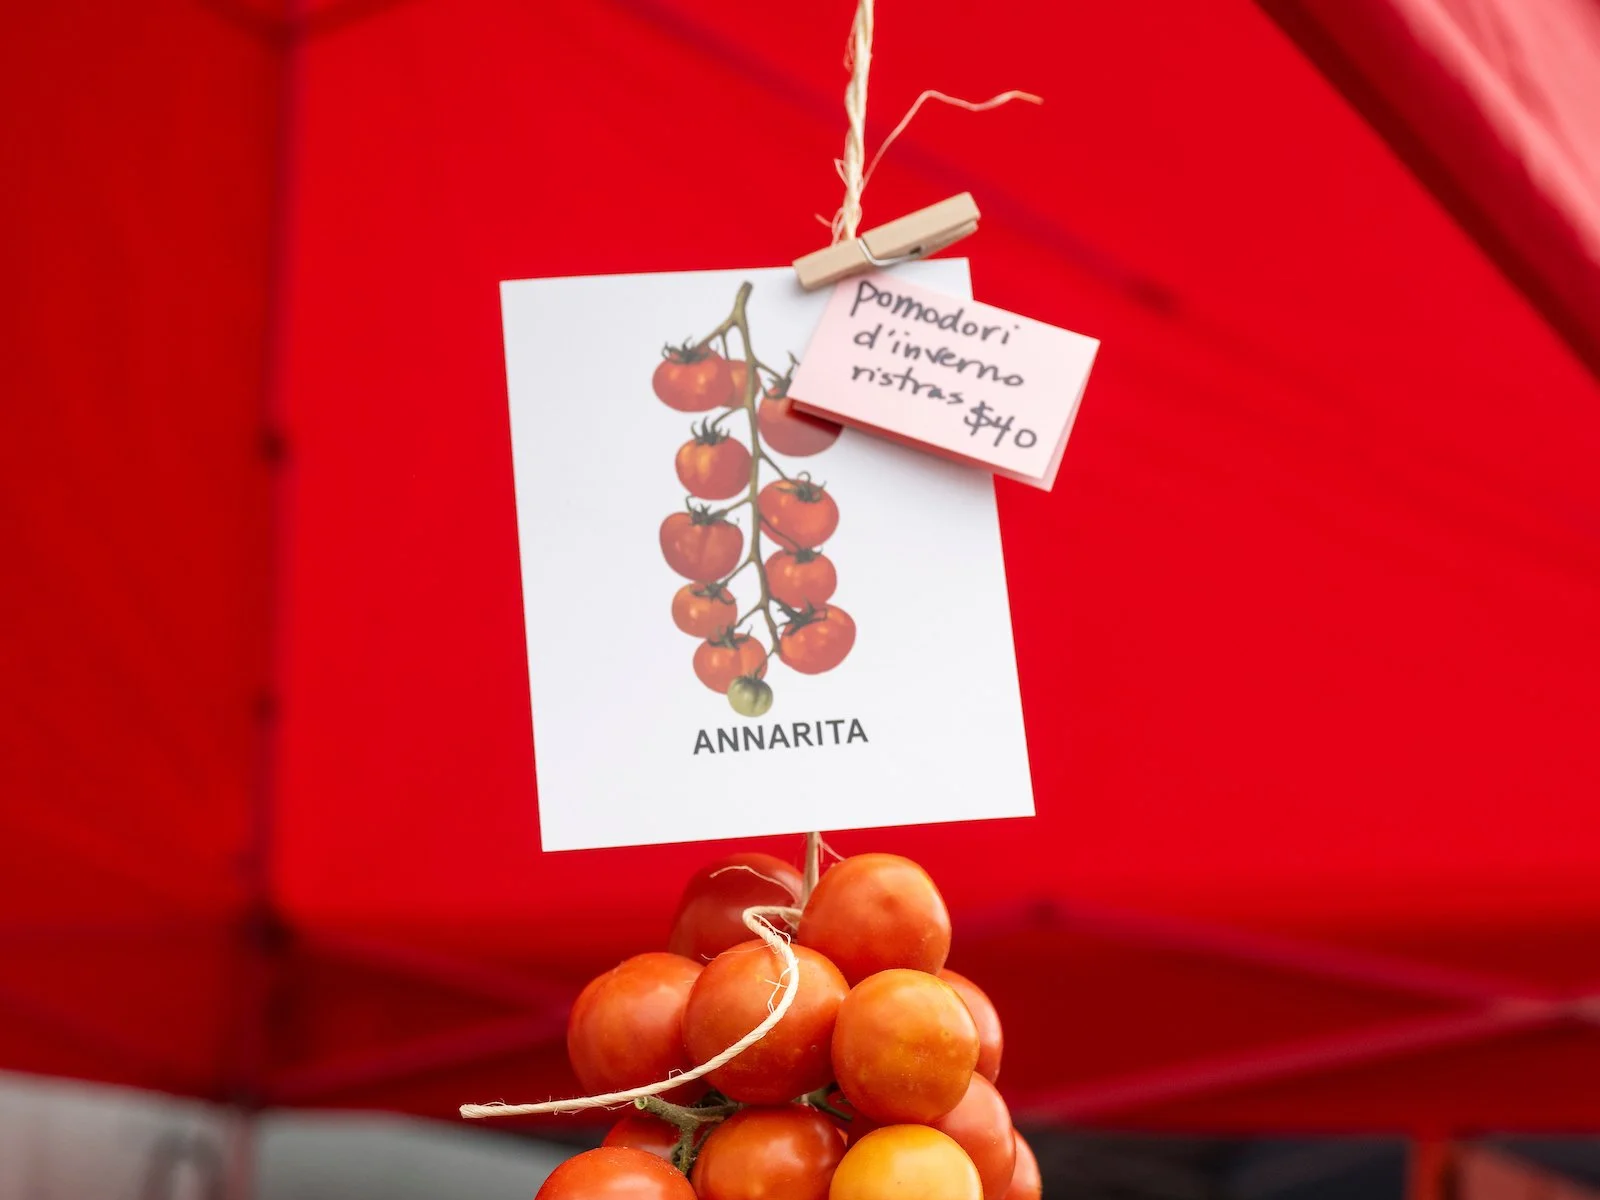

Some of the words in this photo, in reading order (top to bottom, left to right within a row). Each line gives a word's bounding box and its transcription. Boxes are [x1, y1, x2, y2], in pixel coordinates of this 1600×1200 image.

[850, 280, 1020, 345] pomodori
[853, 324, 1025, 387] d'inverno
[851, 365, 964, 405] ristras
[963, 401, 1038, 447] $40
[693, 718, 869, 755] ANNARITA
